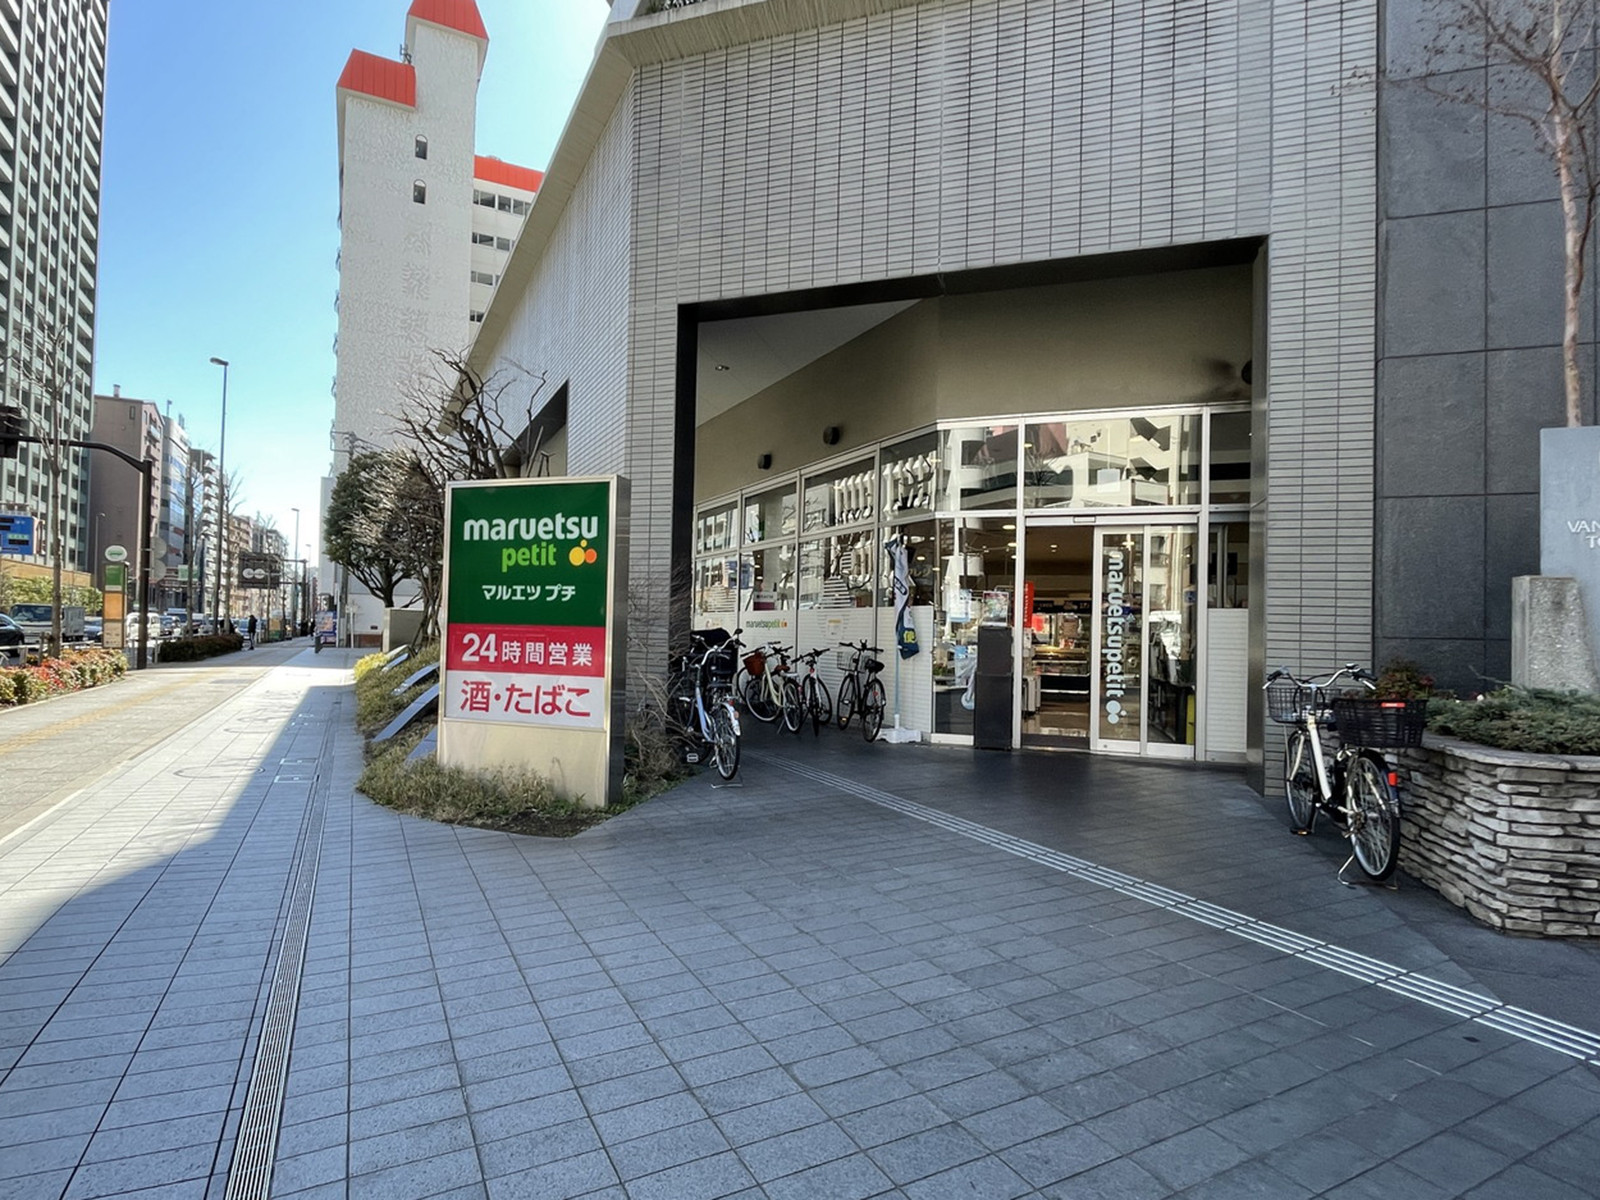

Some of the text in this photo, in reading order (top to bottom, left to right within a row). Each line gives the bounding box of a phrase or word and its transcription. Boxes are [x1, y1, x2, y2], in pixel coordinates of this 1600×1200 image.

[463, 512, 598, 541] maruetsu
[502, 542, 557, 573] petit
[482, 583, 576, 601] マルエツ プチ
[1102, 551, 1126, 697] maruetsupetit
[461, 632, 593, 667] 24時間営業
[460, 680, 591, 717] 酒・たばこ
